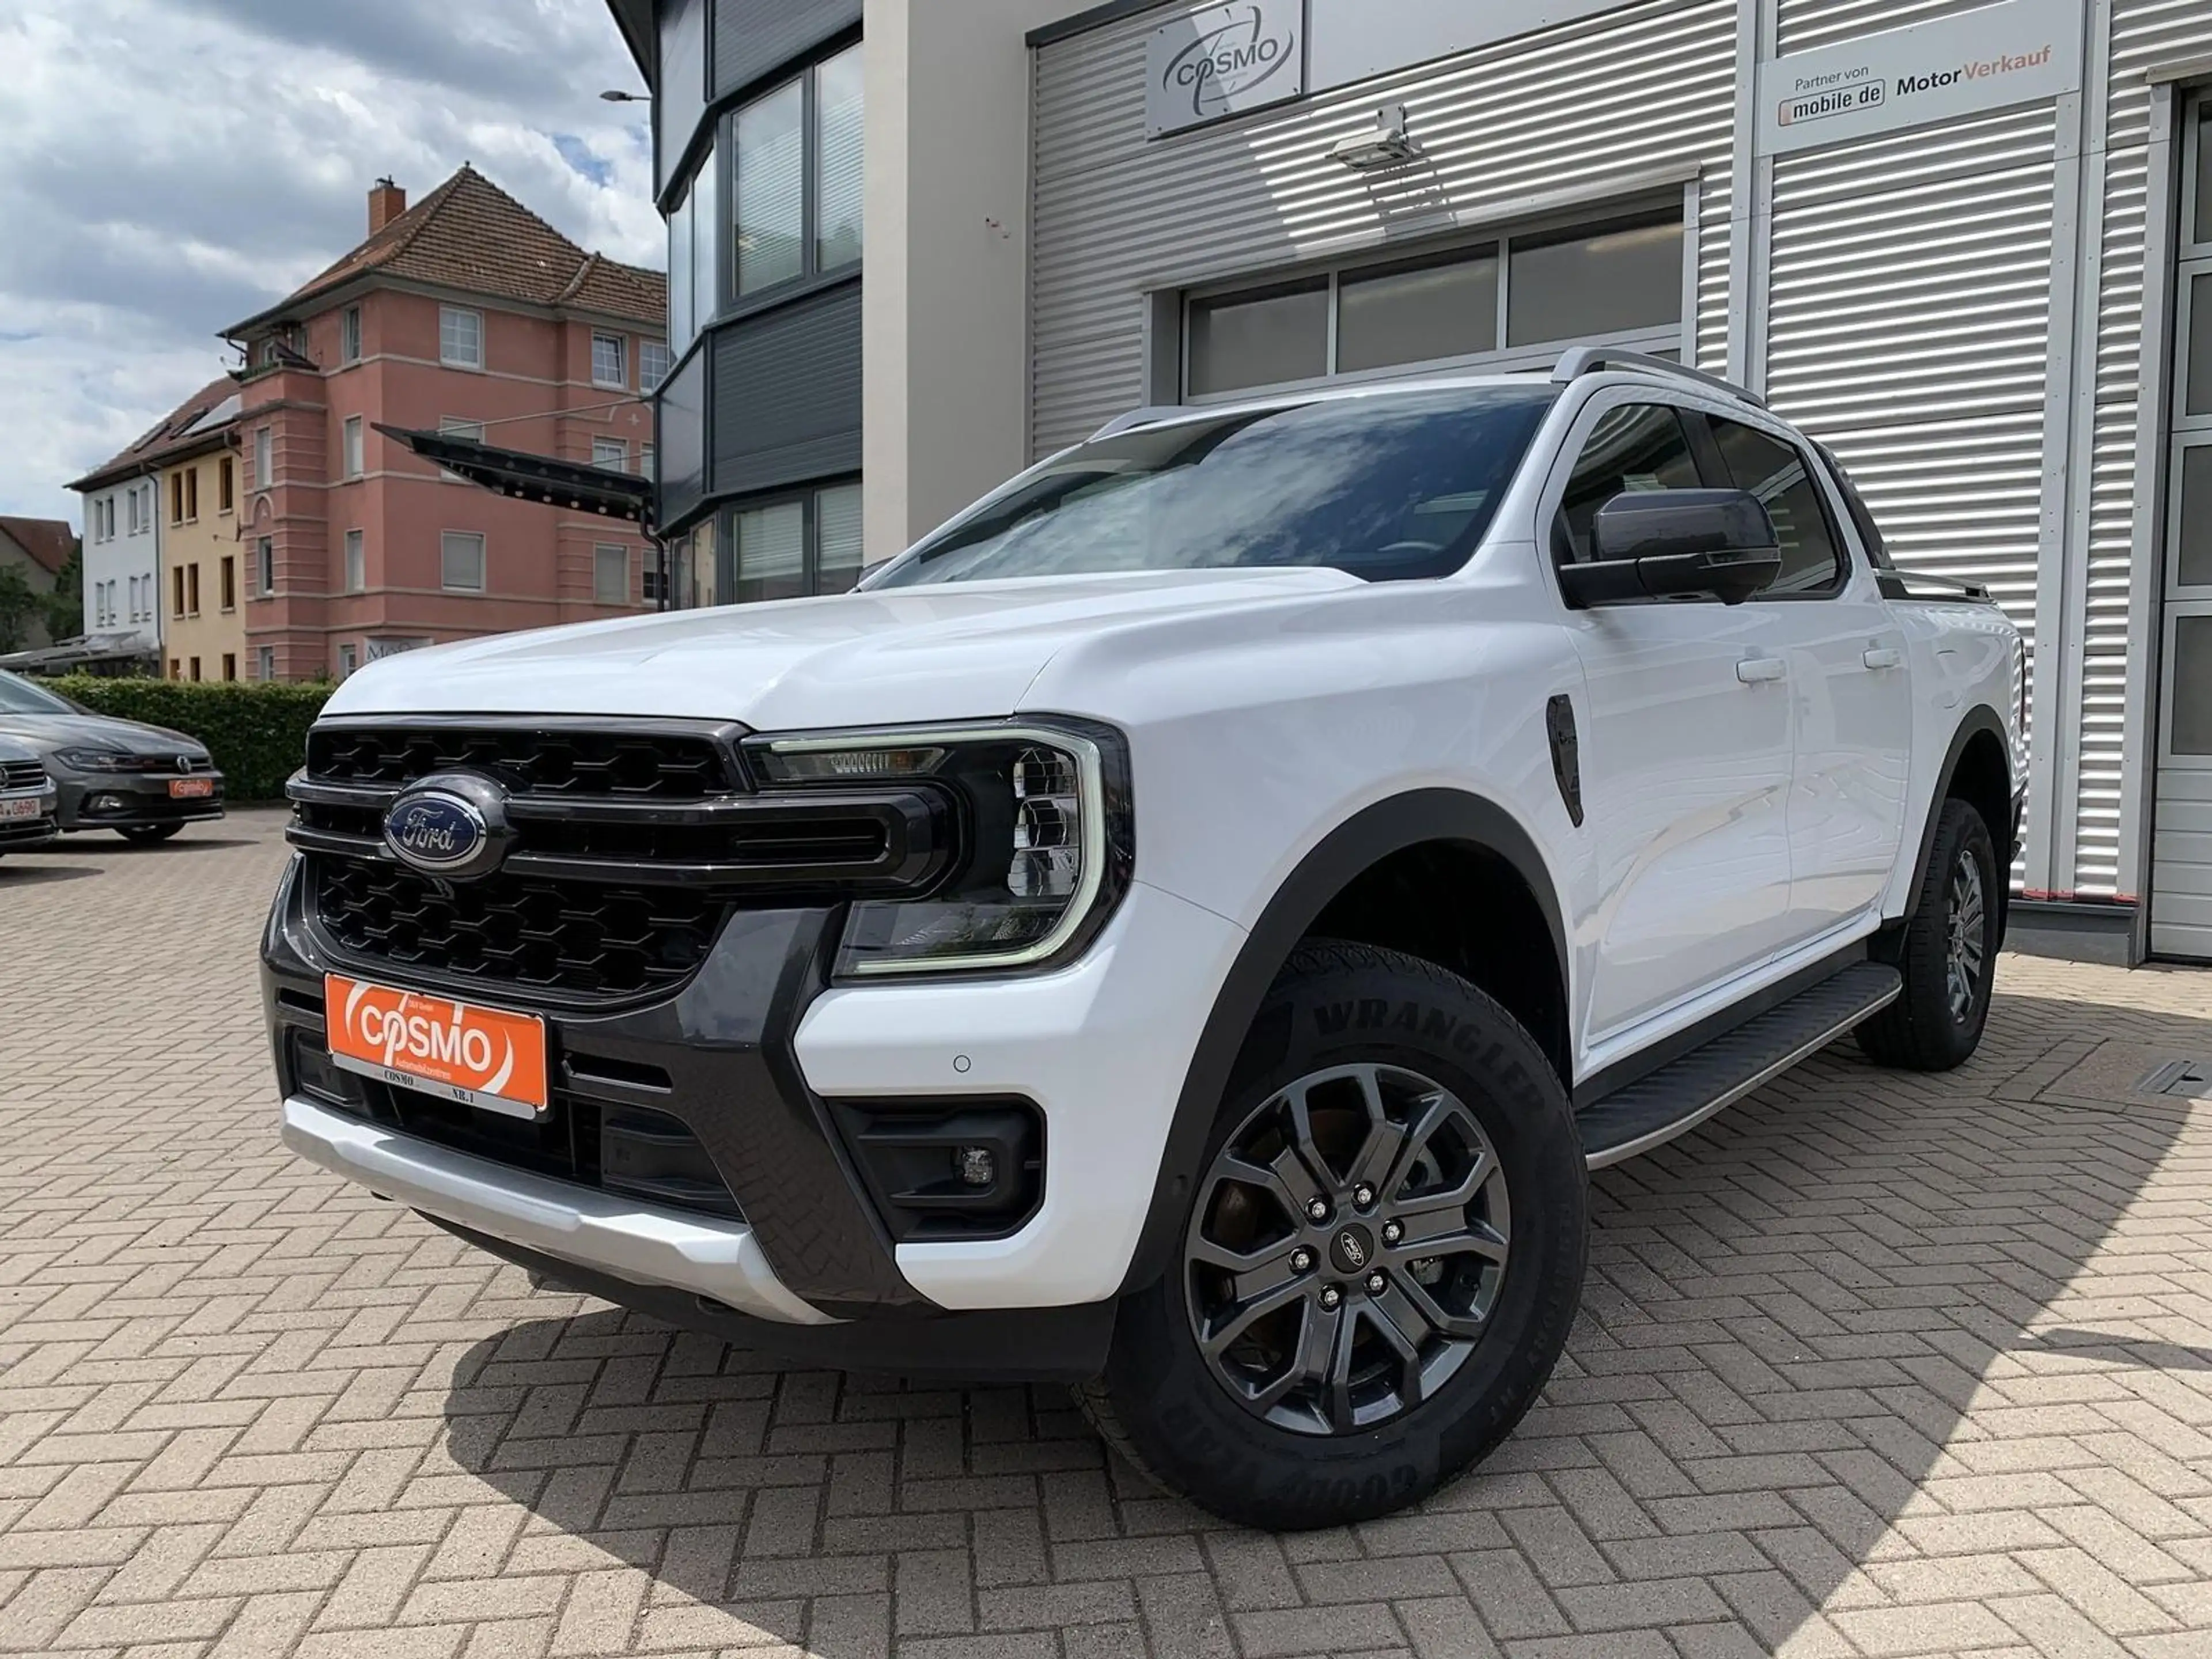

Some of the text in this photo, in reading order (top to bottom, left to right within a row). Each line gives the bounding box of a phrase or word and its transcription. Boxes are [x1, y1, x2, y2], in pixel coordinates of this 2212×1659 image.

[1177, 38, 1278, 86] COSMO
[1795, 66, 1869, 91] Partner von
[1896, 44, 2051, 96] MotorVerkauf
[403, 806, 457, 851] Ford
[361, 1005, 492, 1072] COSMO
[1313, 998, 1546, 1111] WRANGLER
[384, 1070, 414, 1086] COSMO
